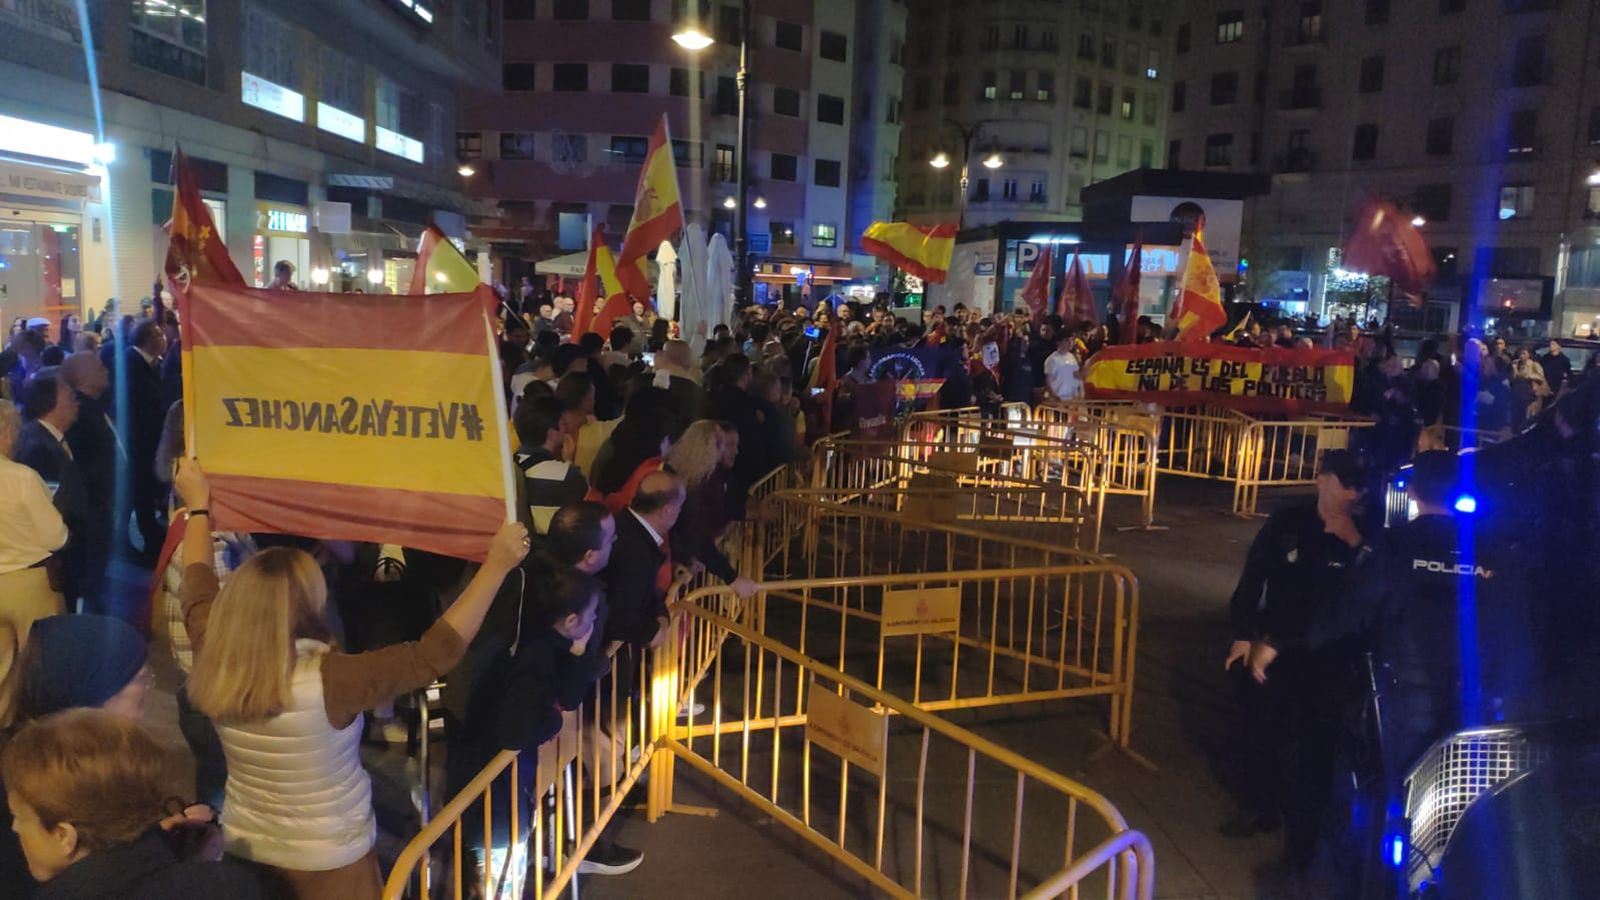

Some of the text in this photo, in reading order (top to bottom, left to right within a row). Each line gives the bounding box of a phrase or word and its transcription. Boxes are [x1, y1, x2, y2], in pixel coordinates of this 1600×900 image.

[1018, 243, 1038, 271] P
[1126, 352, 1184, 374] ESPAÑA
[1191, 358, 1210, 376] ES
[1220, 360, 1249, 378] DEL
[1138, 374, 1160, 391] NO
[1169, 374, 1190, 392] DE
[1201, 375, 1232, 393] LOS
[1413, 559, 1484, 576] POLICIA
